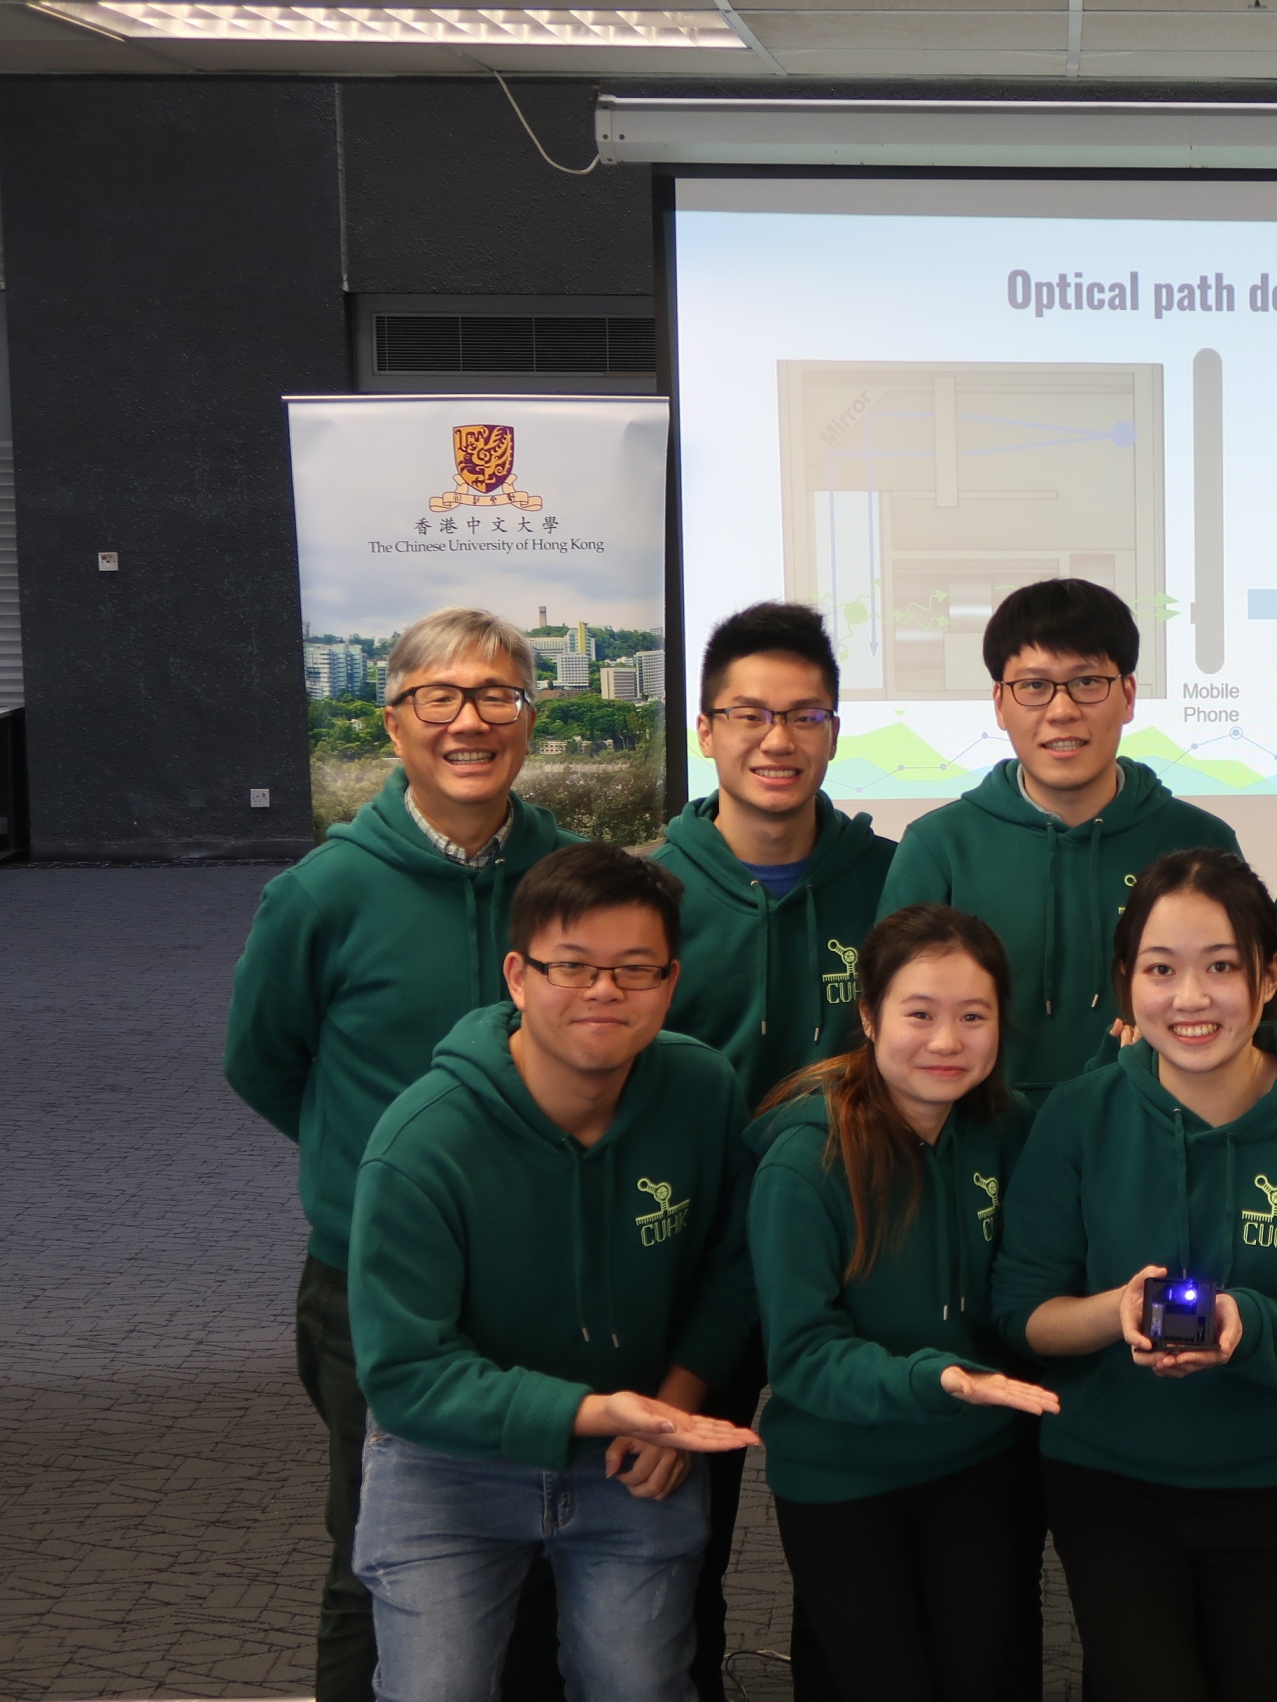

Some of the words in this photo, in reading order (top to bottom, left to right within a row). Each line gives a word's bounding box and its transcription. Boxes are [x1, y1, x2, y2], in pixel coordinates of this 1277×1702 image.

[1007, 269, 1139, 318] Optical
[1154, 272, 1235, 319] path
[818, 390, 872, 447] Mirror
[413, 515, 559, 535] 香港中文大學
[368, 541, 393, 553] The
[395, 540, 446, 552] Chinese
[448, 539, 514, 554] University
[515, 539, 529, 551] of
[532, 538, 568, 554] Hong
[570, 538, 605, 554] Kong
[1183, 683, 1240, 699] Mobile
[1183, 707, 1240, 722] Phone
[640, 1209, 689, 1247] CUHK
